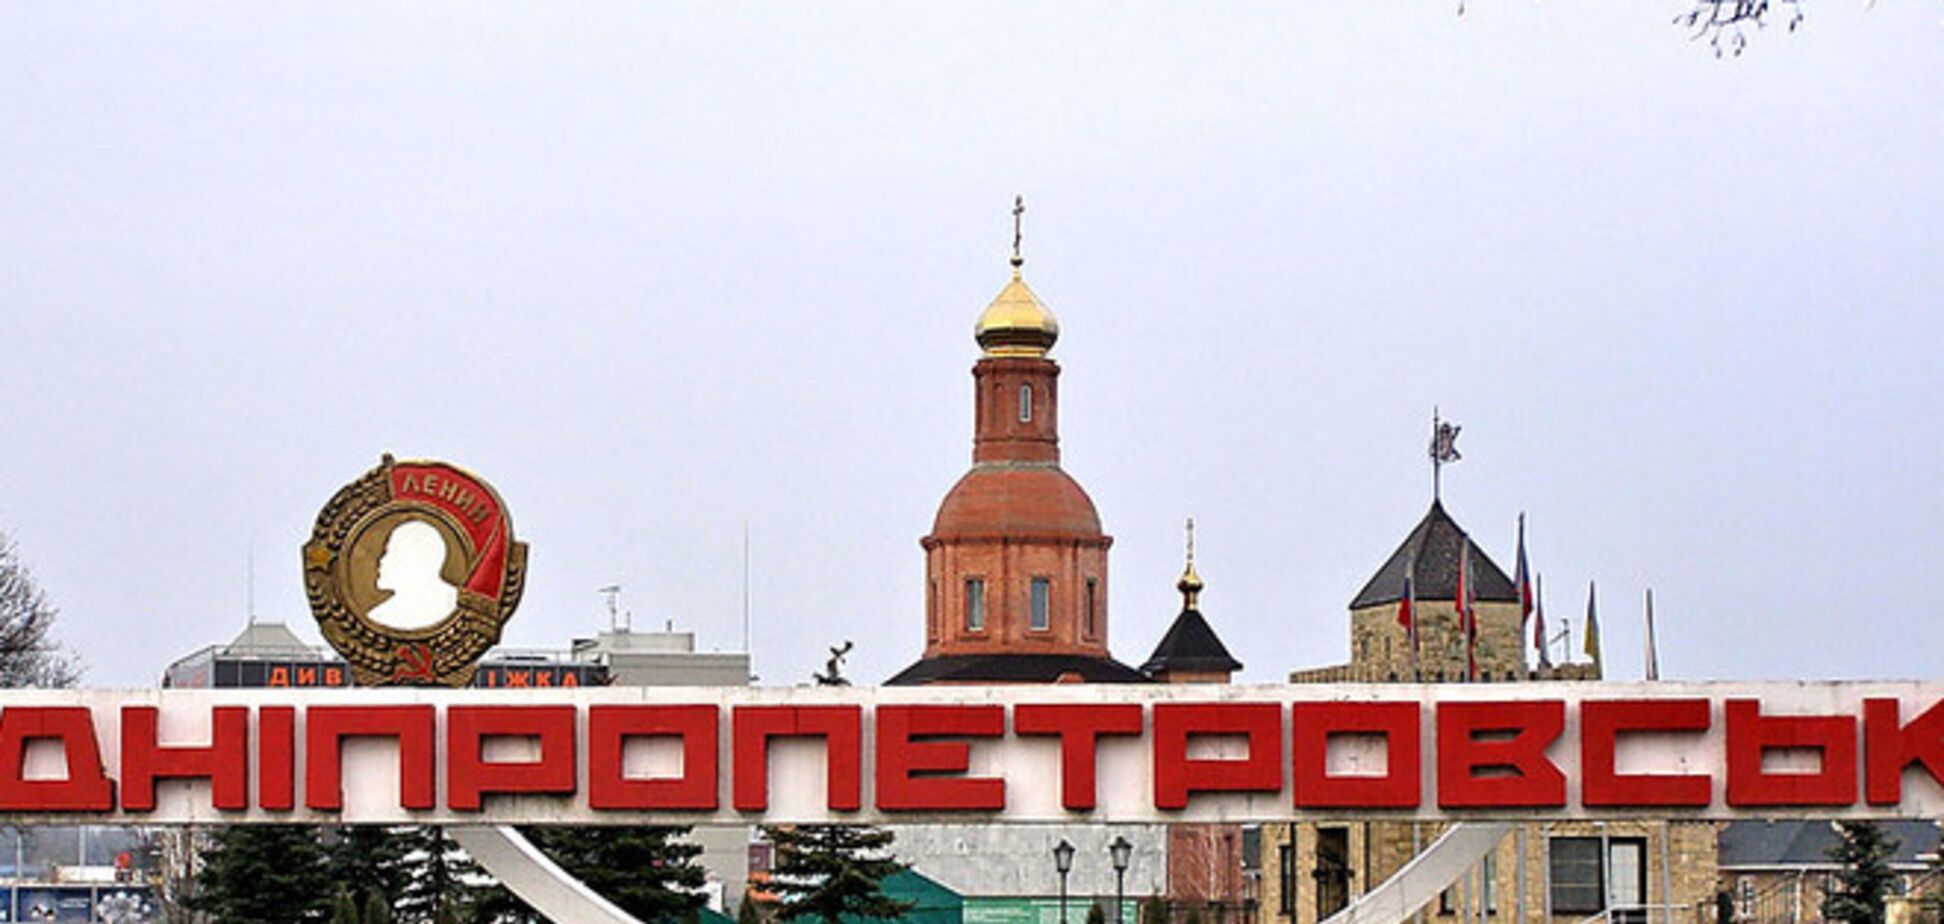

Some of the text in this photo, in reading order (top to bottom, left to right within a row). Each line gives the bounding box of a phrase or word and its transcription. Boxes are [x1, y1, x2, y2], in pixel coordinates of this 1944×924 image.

[402, 472, 489, 524] ЛЕНИН
[269, 666, 579, 688] ДИВ ІЖКА
[0, 697, 1944, 813] ДНІПРОПЕТРОВСЬК
